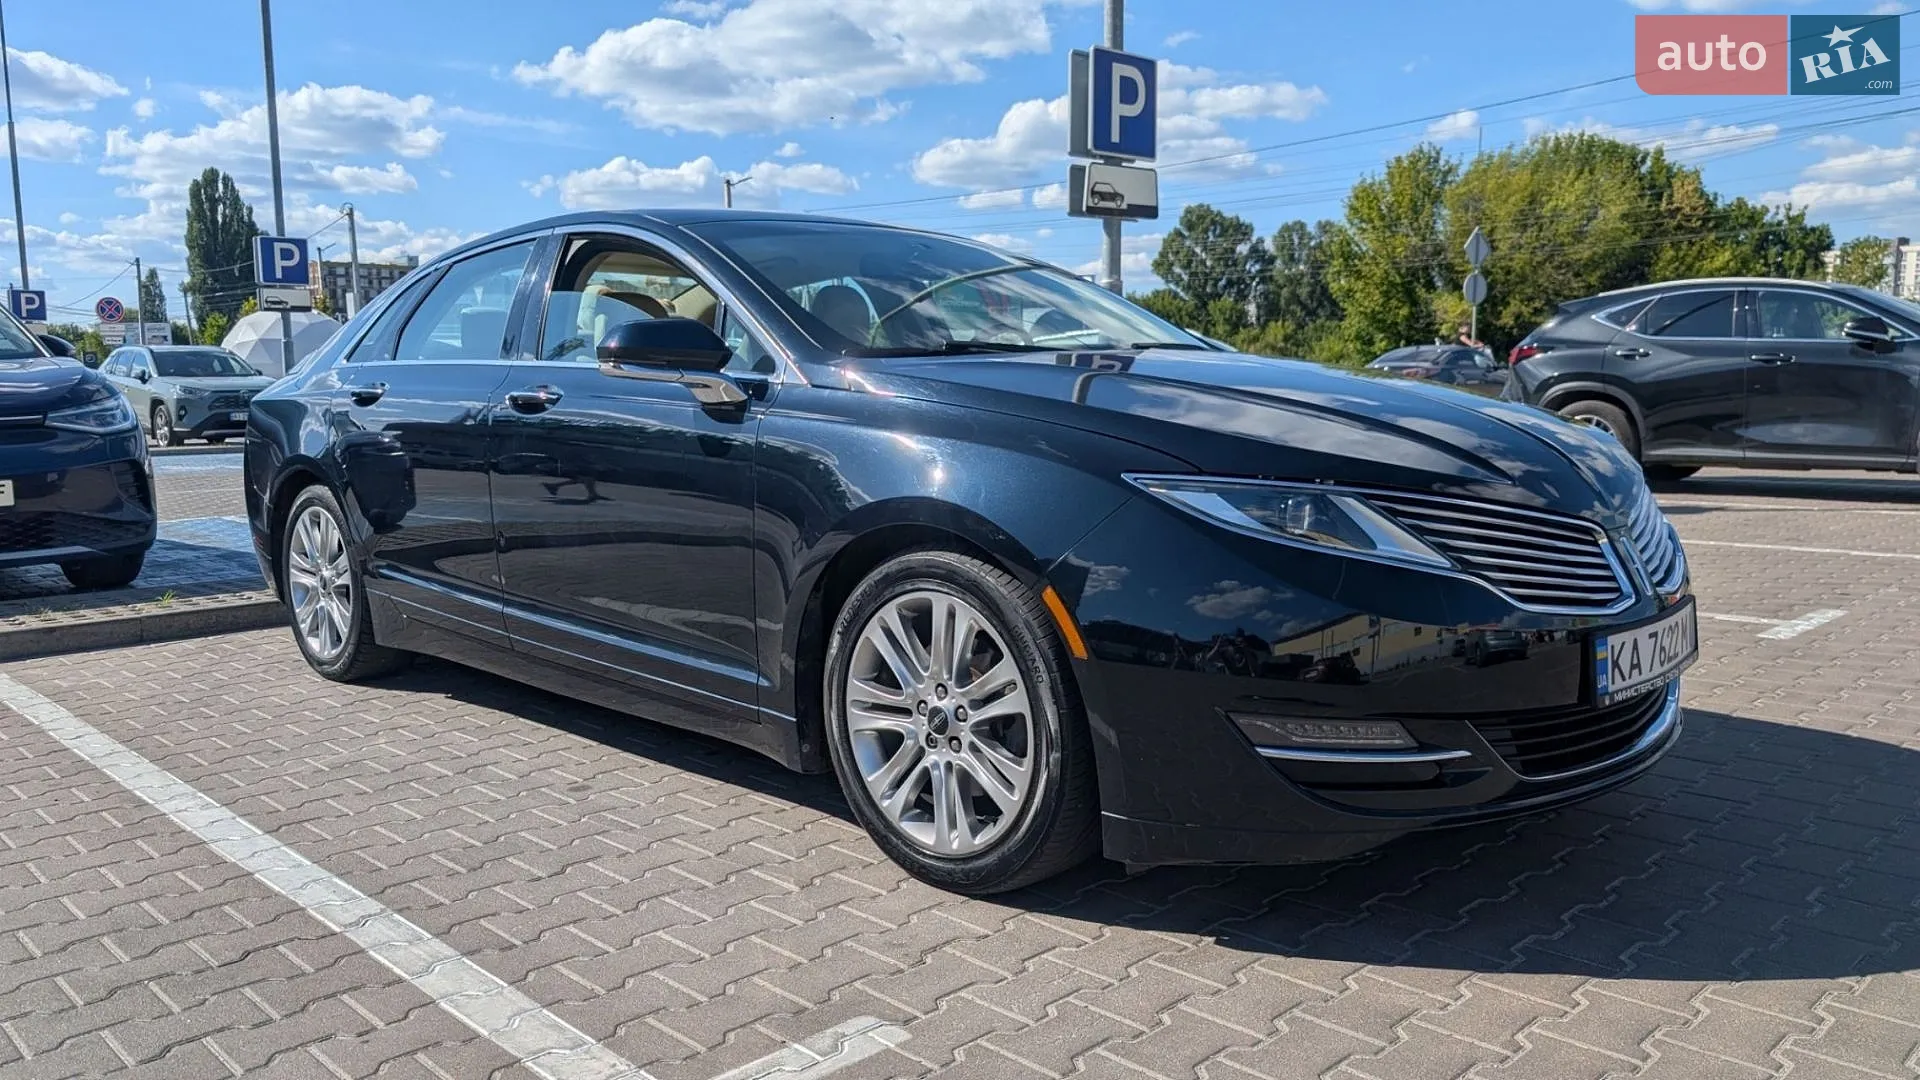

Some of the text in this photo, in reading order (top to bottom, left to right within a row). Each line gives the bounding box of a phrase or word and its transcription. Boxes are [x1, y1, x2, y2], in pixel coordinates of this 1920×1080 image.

[1110, 62, 1146, 143] P
[273, 241, 300, 279] P
[20, 292, 40, 317] P
[1610, 637, 1643, 685] KA
[1648, 620, 1680, 673] 7622
[1597, 674, 1608, 688] UA
